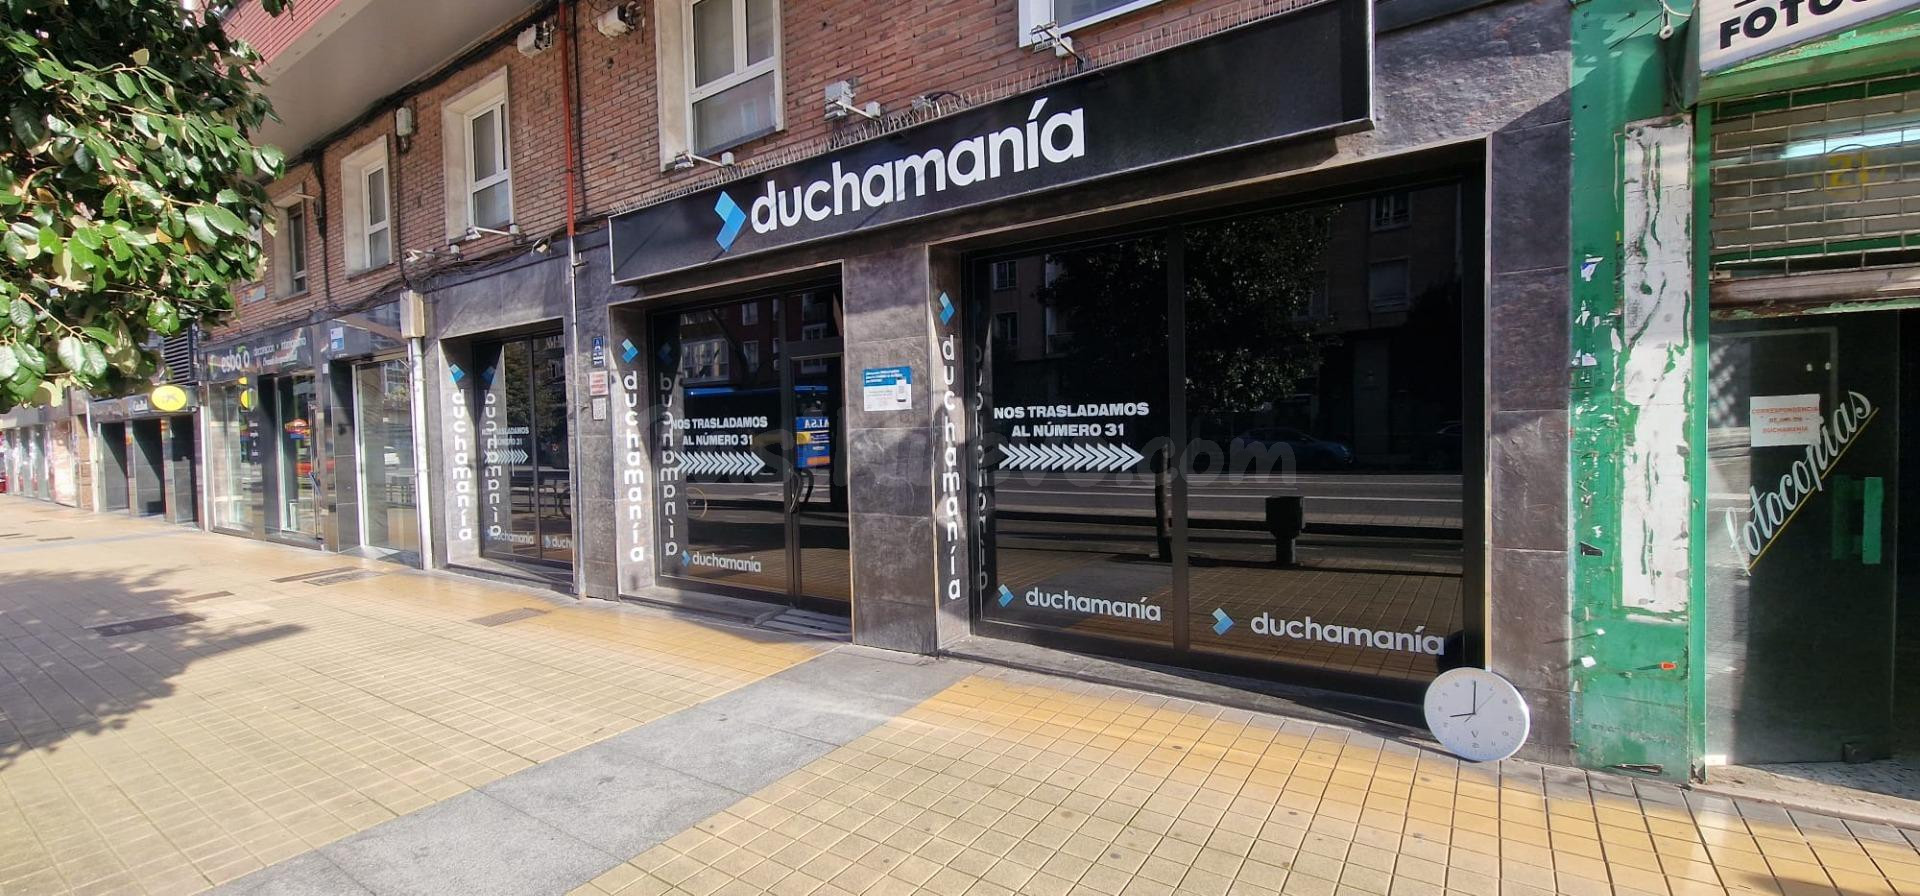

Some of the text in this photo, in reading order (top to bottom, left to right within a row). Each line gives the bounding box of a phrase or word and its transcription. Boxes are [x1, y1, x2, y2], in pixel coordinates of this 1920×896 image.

[1720, 0, 1867, 49] FOTO
[750, 97, 1086, 235] duchamanía
[671, 416, 768, 430] NOS TRASLADAMOS
[994, 402, 1149, 420] NOS TRASLADAMOS
[1012, 421, 1125, 437] AL NÚMERO 31
[682, 432, 753, 446] AL NÚMERO 31
[452, 388, 472, 541] duchamanía
[623, 370, 645, 562] duchamanía
[942, 334, 961, 600] duchamanía
[1725, 390, 1872, 577] fotocopias
[692, 552, 761, 573] duchamanía
[1025, 587, 1161, 622] duchamanía
[1250, 612, 1445, 656] duchamanía
